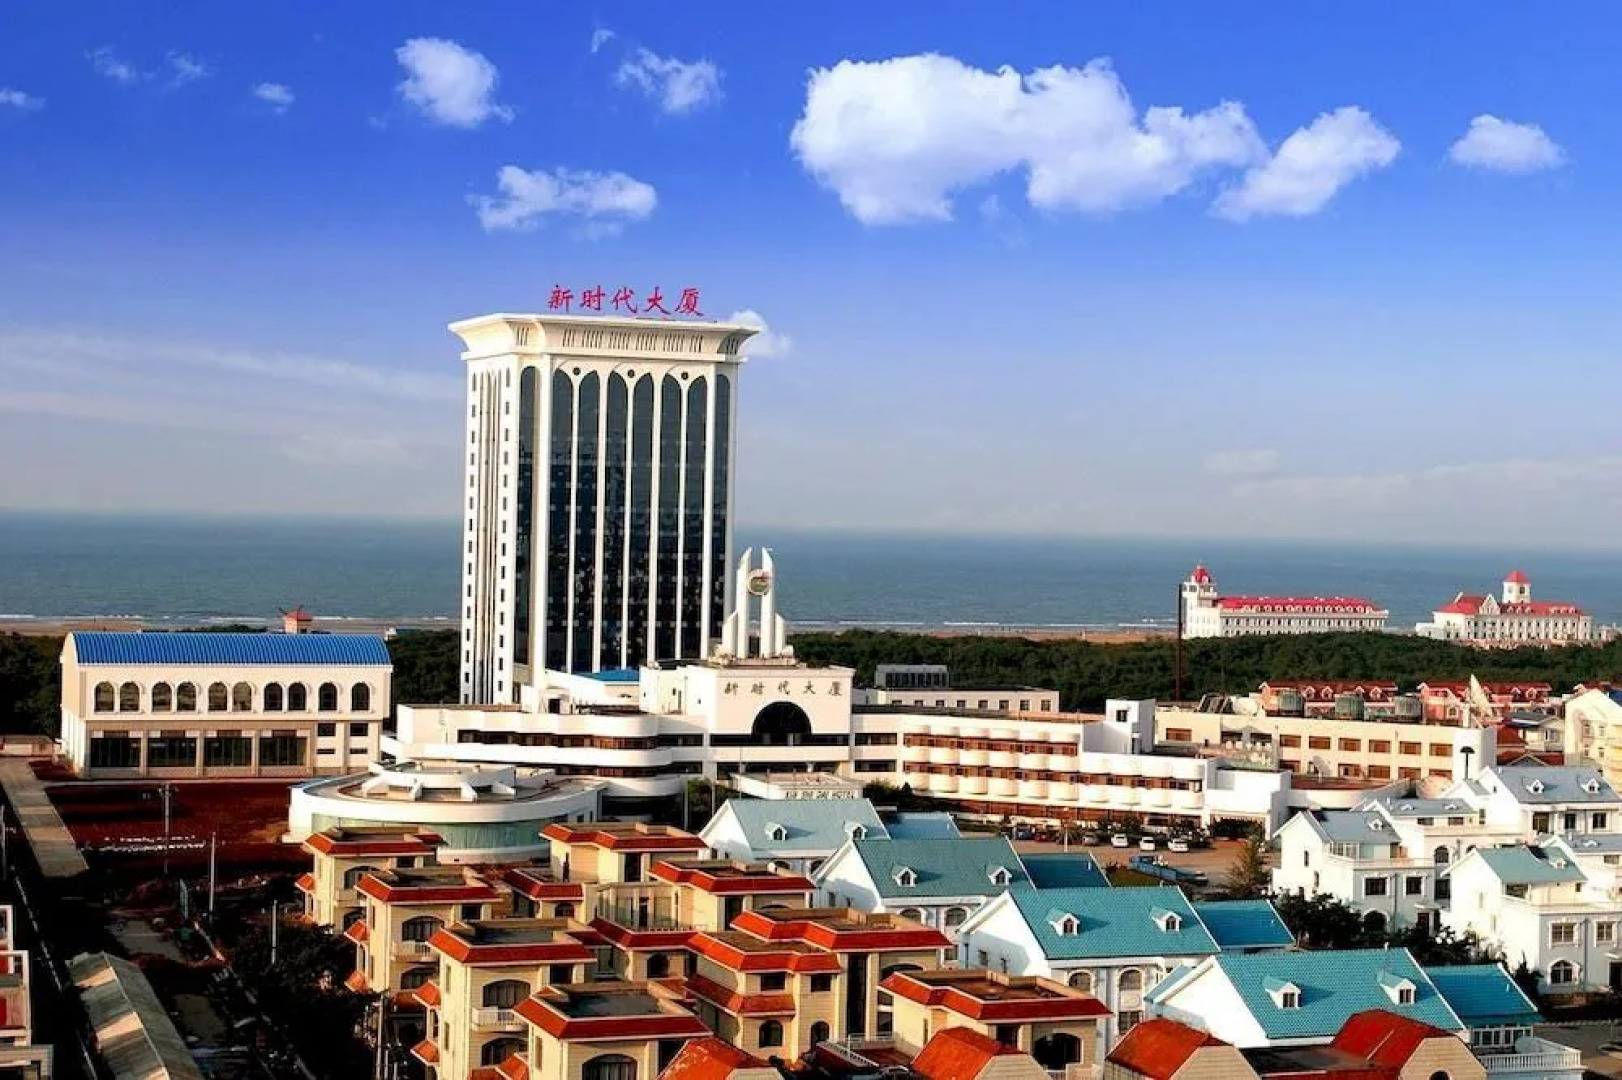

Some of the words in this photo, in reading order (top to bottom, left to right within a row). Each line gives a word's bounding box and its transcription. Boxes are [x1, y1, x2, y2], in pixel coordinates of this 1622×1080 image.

[547, 284, 704, 316] 新时代大厦
